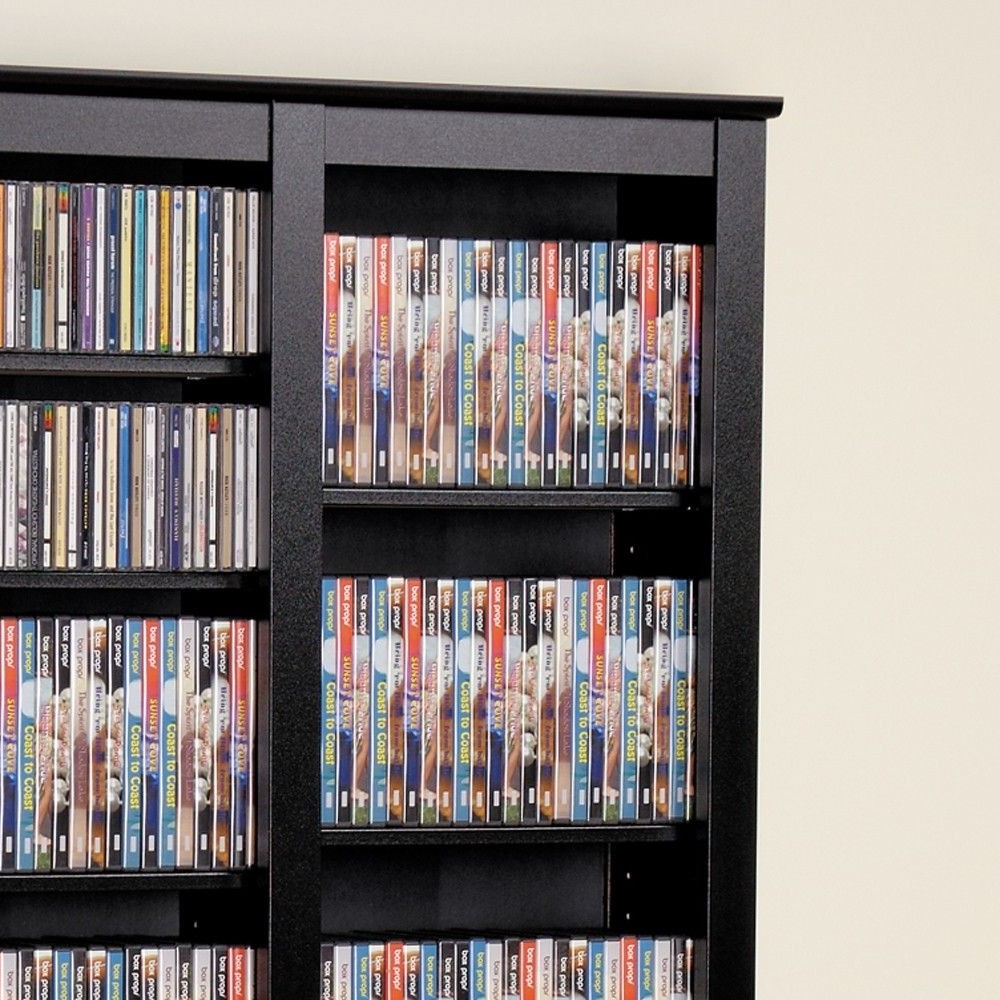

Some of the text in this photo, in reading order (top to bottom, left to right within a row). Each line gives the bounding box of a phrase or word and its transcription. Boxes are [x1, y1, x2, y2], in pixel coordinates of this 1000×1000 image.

[466, 343, 475, 374] Coast
[516, 345, 525, 375] Coast
[598, 343, 608, 374] Coast
[464, 394, 473, 425] Coast
[514, 394, 524, 425] Coast
[598, 394, 607, 426] Coast
[326, 682, 336, 713] Coast
[378, 680, 387, 712] Coast
[462, 681, 471, 712] Coast
[580, 681, 590, 712] Coast
[628, 680, 638, 711] Coast
[678, 680, 687, 710] Coast
[24, 723, 35, 757] Coast
[132, 726, 142, 758] Coast
[168, 723, 178, 756] Coast
[326, 733, 335, 764] Coast
[378, 732, 387, 764] Coast
[460, 732, 470, 763] Coast
[580, 732, 589, 763] Coast
[626, 730, 636, 761] Coast
[676, 729, 686, 760] Coast
[24, 777, 34, 810] Coast
[130, 777, 141, 808] Coast
[166, 775, 177, 807] Coast
